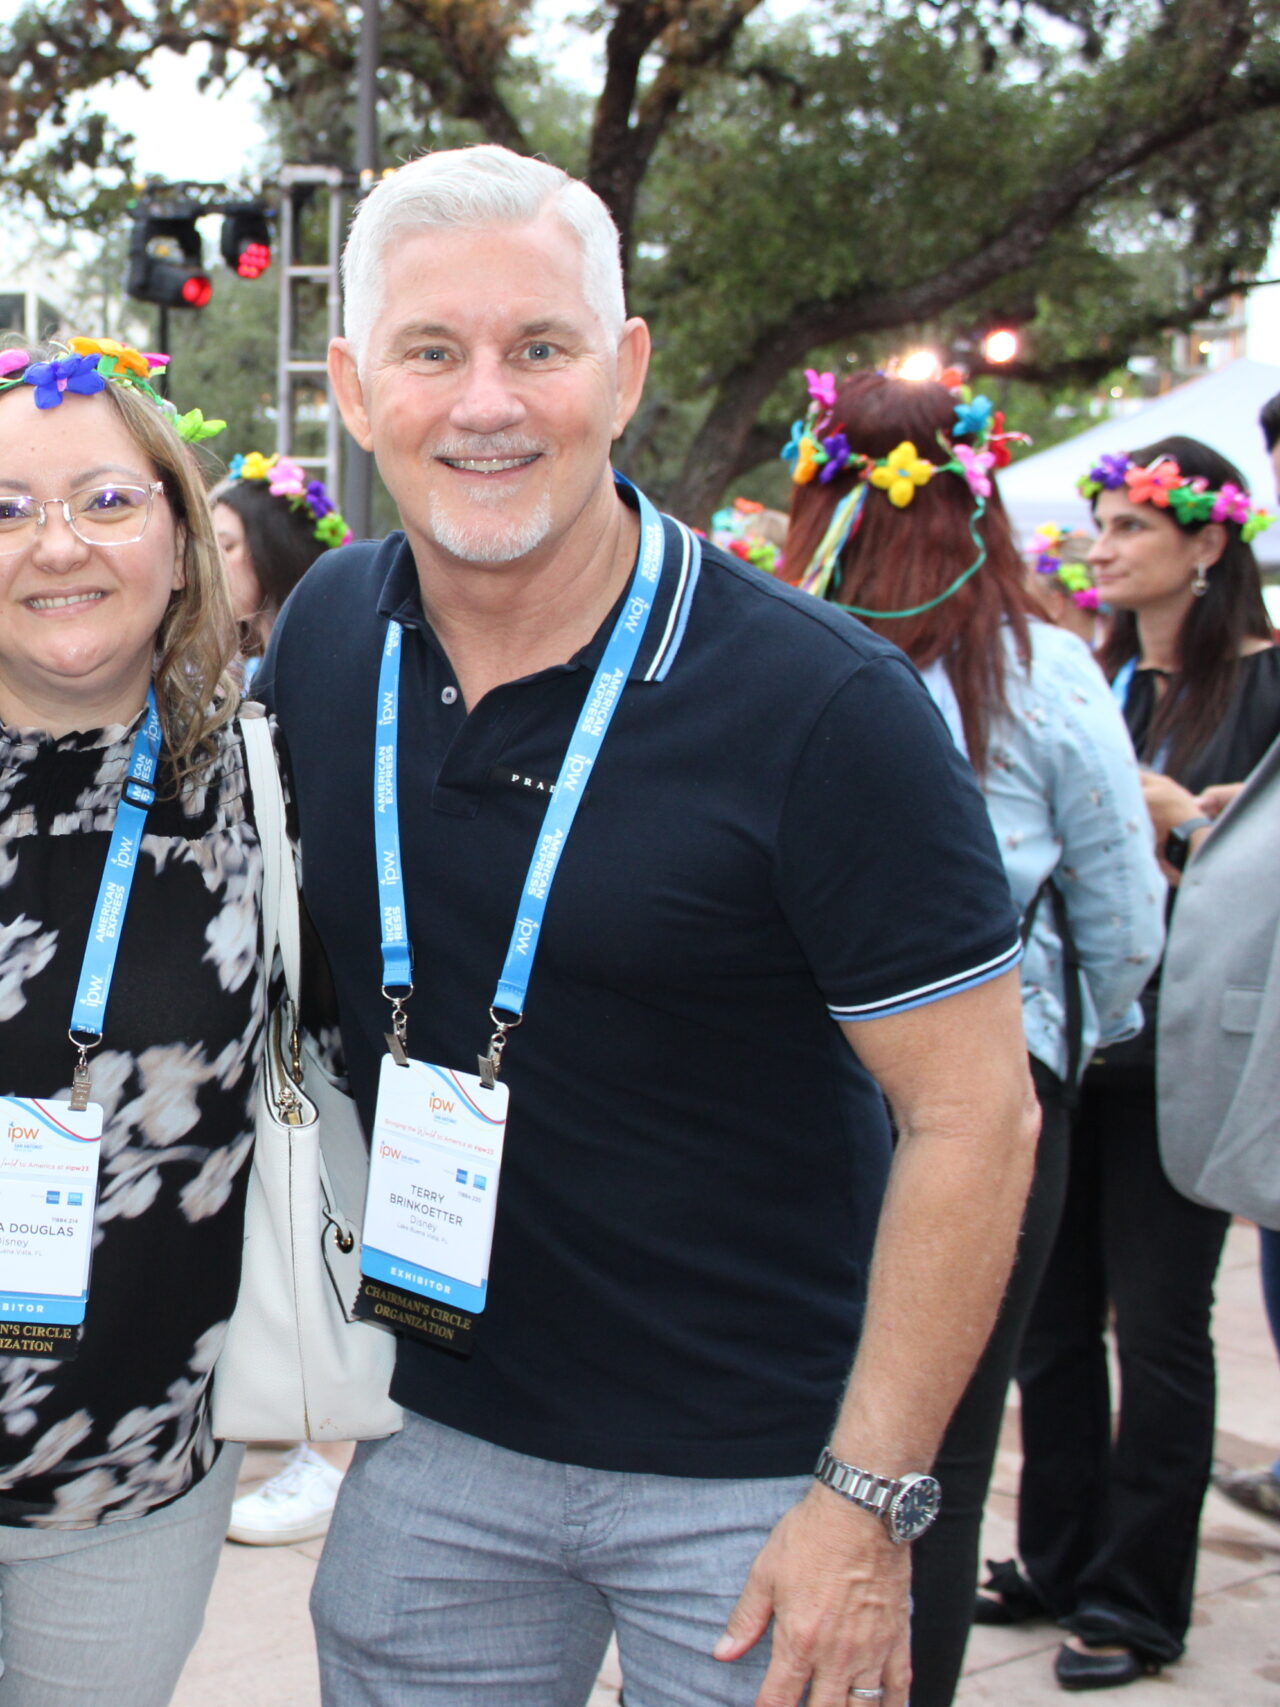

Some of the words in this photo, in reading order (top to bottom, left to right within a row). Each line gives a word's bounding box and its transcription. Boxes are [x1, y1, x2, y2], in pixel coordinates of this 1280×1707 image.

[624, 596, 650, 633] ipw
[378, 692, 396, 726] ipw
[581, 672, 612, 733] EXPRESS
[591, 668, 624, 737] AMERICAN
[378, 746, 387, 813] AMERICAN
[385, 745, 394, 804] EXPRESS
[511, 774, 557, 793] PRAD
[563, 753, 592, 791] ipw
[111, 837, 133, 868] ipw
[380, 851, 400, 885] ipw
[528, 834, 553, 897] EXPRESS
[538, 828, 563, 899] AMERICAN
[95, 881, 117, 943] AMERICAN
[106, 885, 125, 938] EXPRESS
[384, 906, 394, 943] RICAN
[393, 906, 403, 940] RESS
[517, 917, 539, 956] ipw
[80, 975, 104, 1008] ipw
[429, 1092, 455, 1113] ipw
[8, 1122, 39, 1142] ipw
[379, 1141, 402, 1160] ipw
[390, 1193, 463, 1226] BRINKOETTER
[411, 1184, 445, 1203] TERRY
[9, 1222, 74, 1237] DOUGLAS
[410, 1215, 438, 1232] Disney
[390, 1267, 452, 1294] EXHIBITOR
[365, 1285, 430, 1316] CHAIRMAN'S
[431, 1305, 471, 1330] CIRCLE
[374, 1304, 455, 1340] ORGANIZATION
[23, 1325, 72, 1339] CIRCLE
